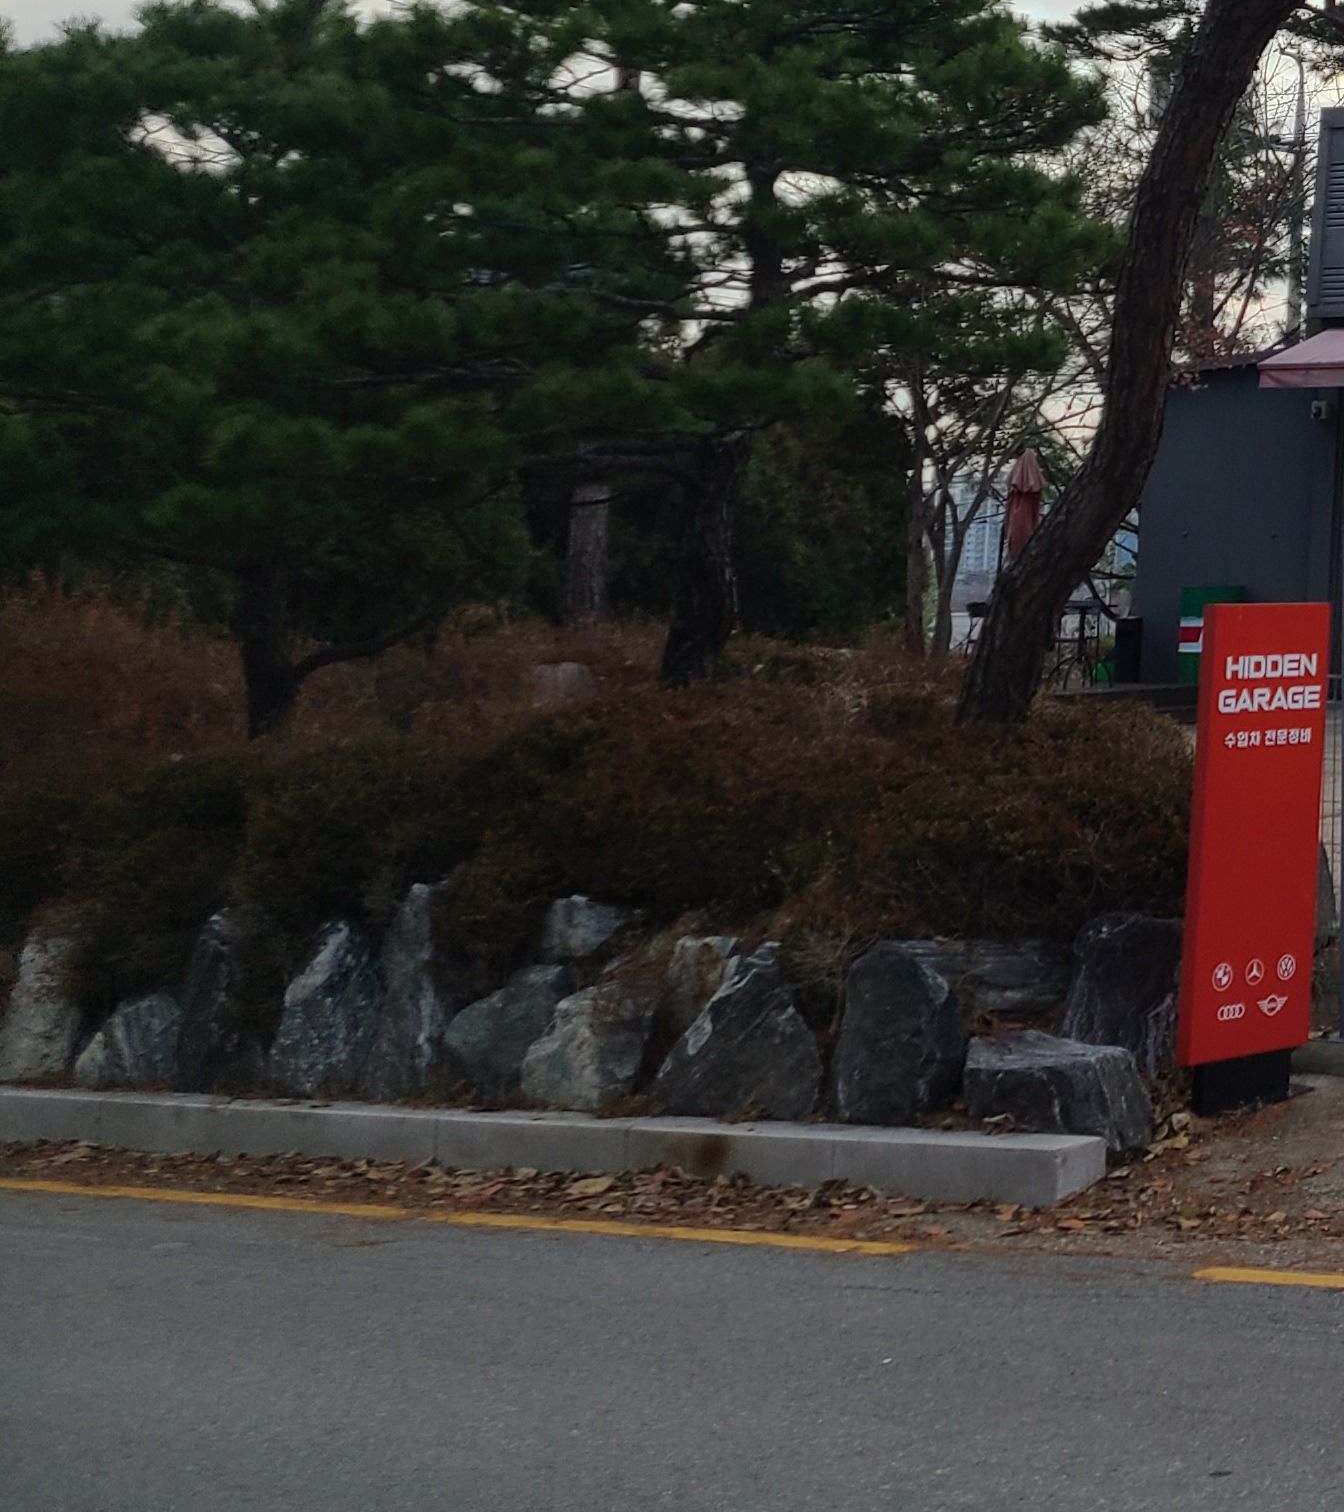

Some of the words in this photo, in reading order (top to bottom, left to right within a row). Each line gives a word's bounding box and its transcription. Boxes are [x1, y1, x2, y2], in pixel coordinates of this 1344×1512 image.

[1225, 653, 1318, 680] HIDDEN
[1218, 685, 1322, 714] GARAGE
[1224, 731, 1260, 748] 수입차
[1265, 728, 1312, 745] 전문정비
